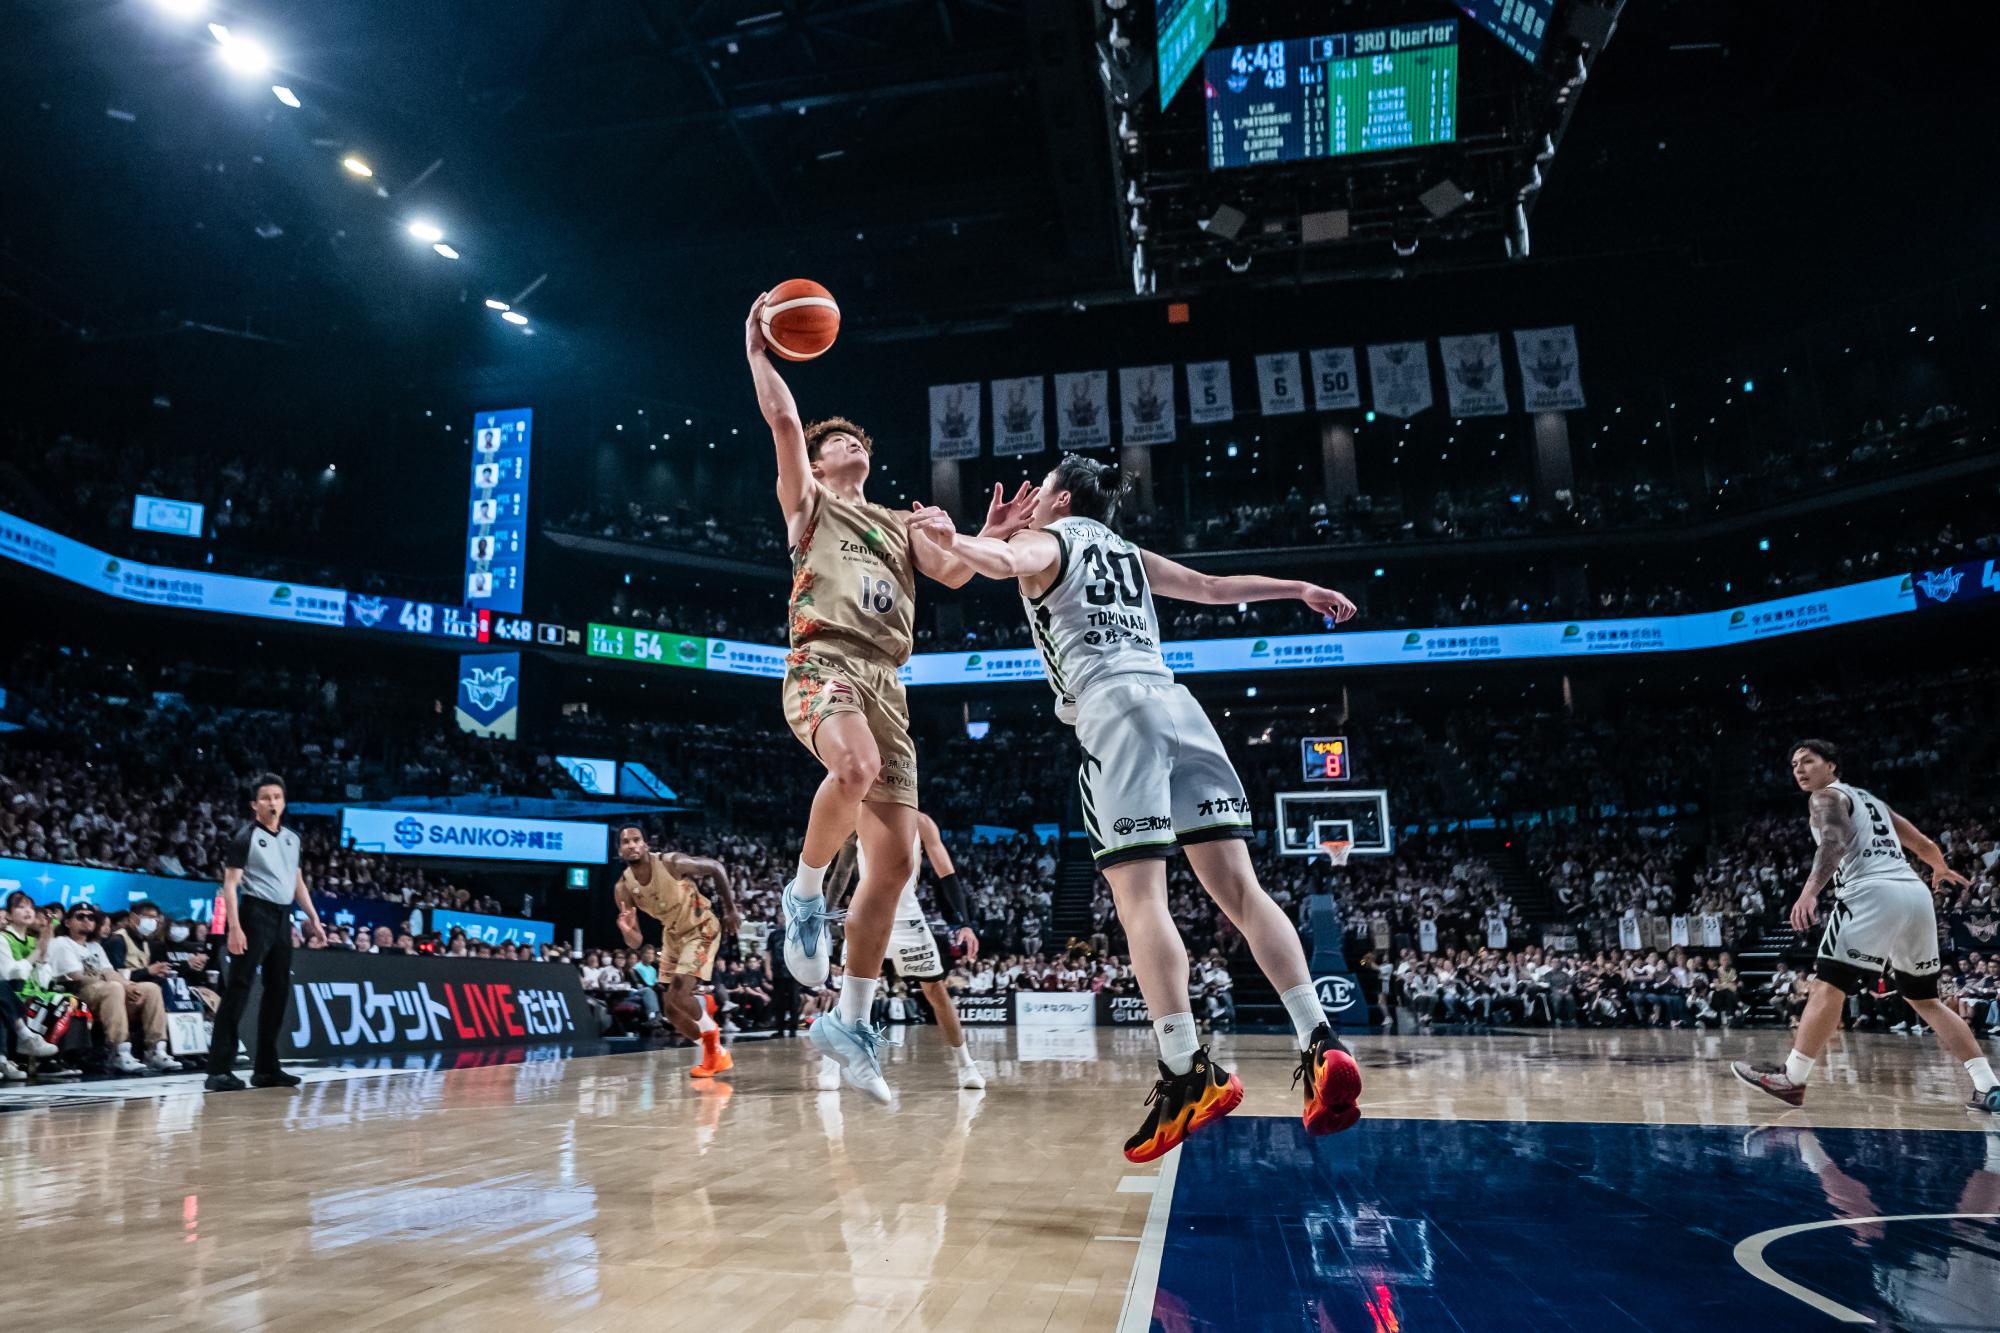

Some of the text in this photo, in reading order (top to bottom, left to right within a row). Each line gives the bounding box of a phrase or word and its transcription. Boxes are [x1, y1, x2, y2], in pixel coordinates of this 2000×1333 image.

[1354, 25, 1454, 53] 3RD Quarter
[1231, 41, 1285, 74] 4:48
[1372, 55, 1393, 76] 54
[1264, 68, 1287, 89] 48
[1274, 377, 1288, 396] 6
[1322, 372, 1349, 392] 50
[1204, 385, 1217, 405] 5
[1083, 544, 1145, 608] 30
[861, 575, 893, 614] 18
[400, 601, 434, 633] 48
[495, 617, 532, 642] 4:48
[634, 631, 663, 660] 54
[1313, 741, 1343, 755] 4:48
[1326, 755, 1341, 777] 8
[1034, 1003, 1089, 1013] りそなグループ
